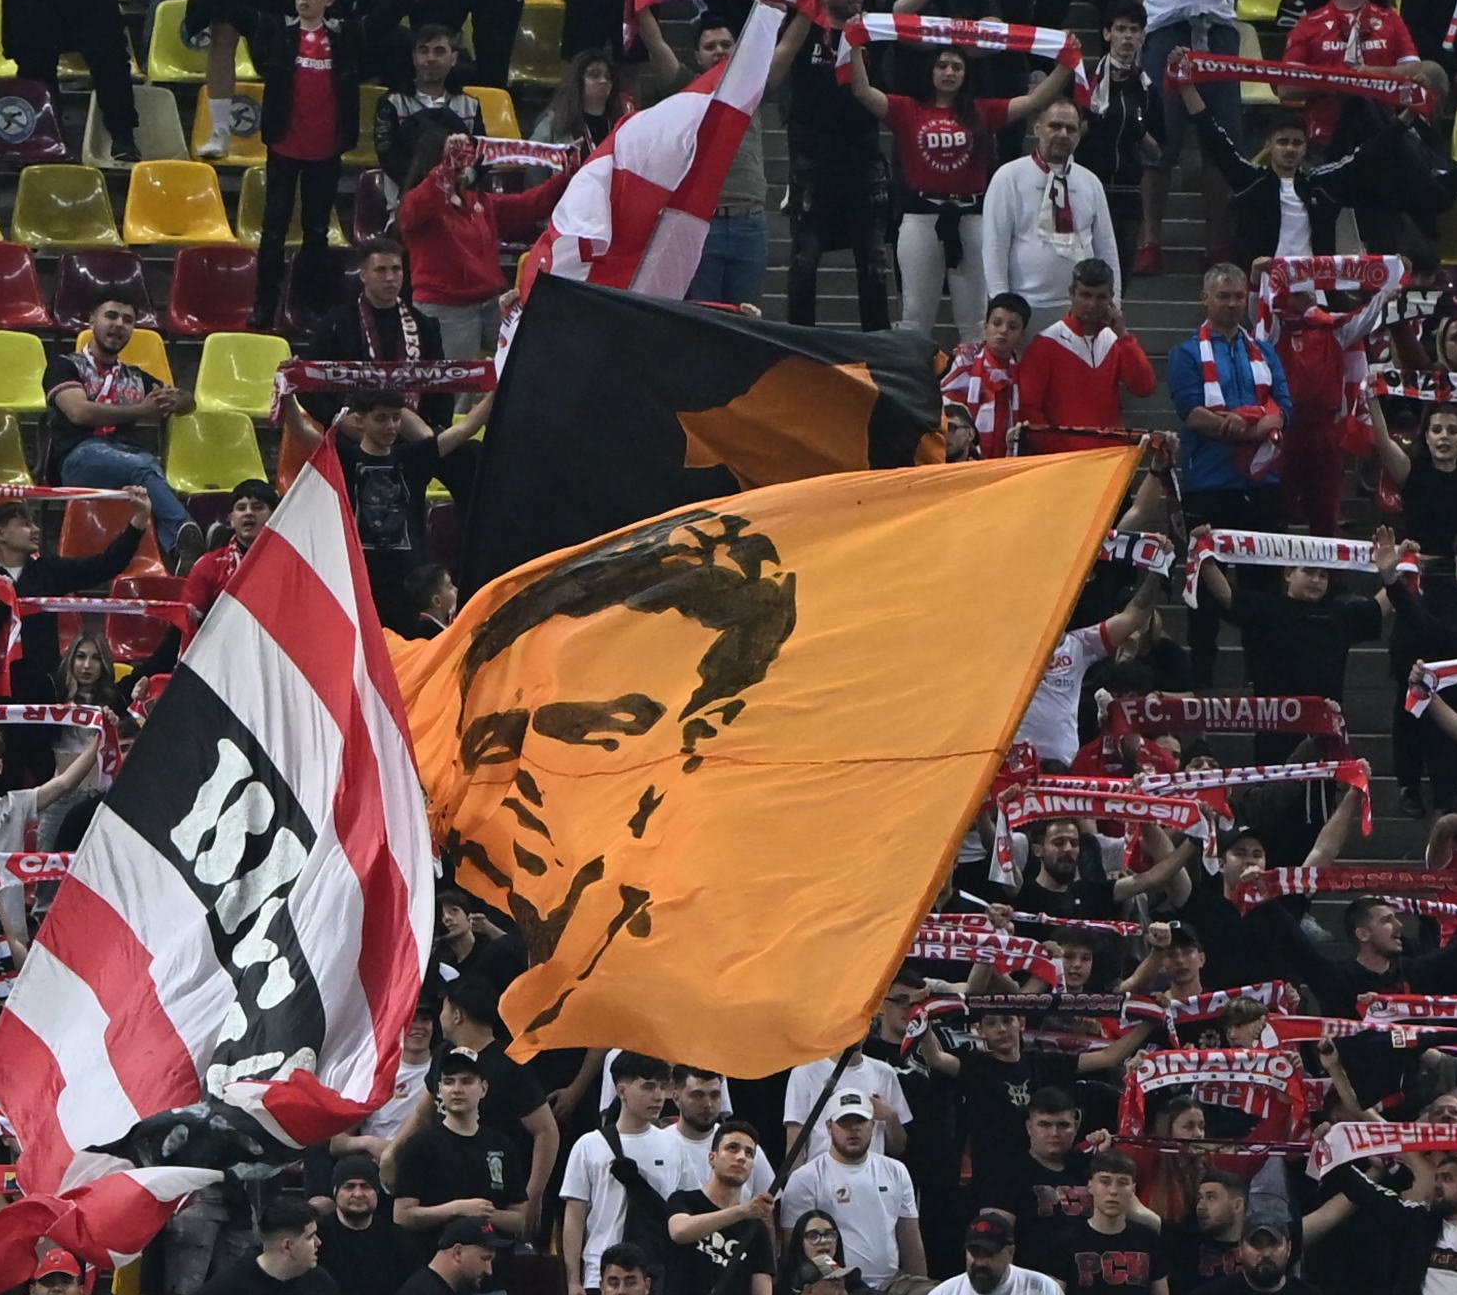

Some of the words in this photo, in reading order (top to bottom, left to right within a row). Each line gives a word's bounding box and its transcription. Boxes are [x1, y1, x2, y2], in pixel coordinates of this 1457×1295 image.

[927, 128, 967, 150] DDB
[325, 364, 469, 384] DINAMO
[1258, 537, 1342, 564] DINAMO
[1123, 701, 1171, 726] F.C.
[1183, 697, 1302, 722] DINAMO
[1007, 794, 1097, 820] CAINII
[1137, 1052, 1293, 1081] DINAMO
[1073, 1250, 1150, 1287] PCH
